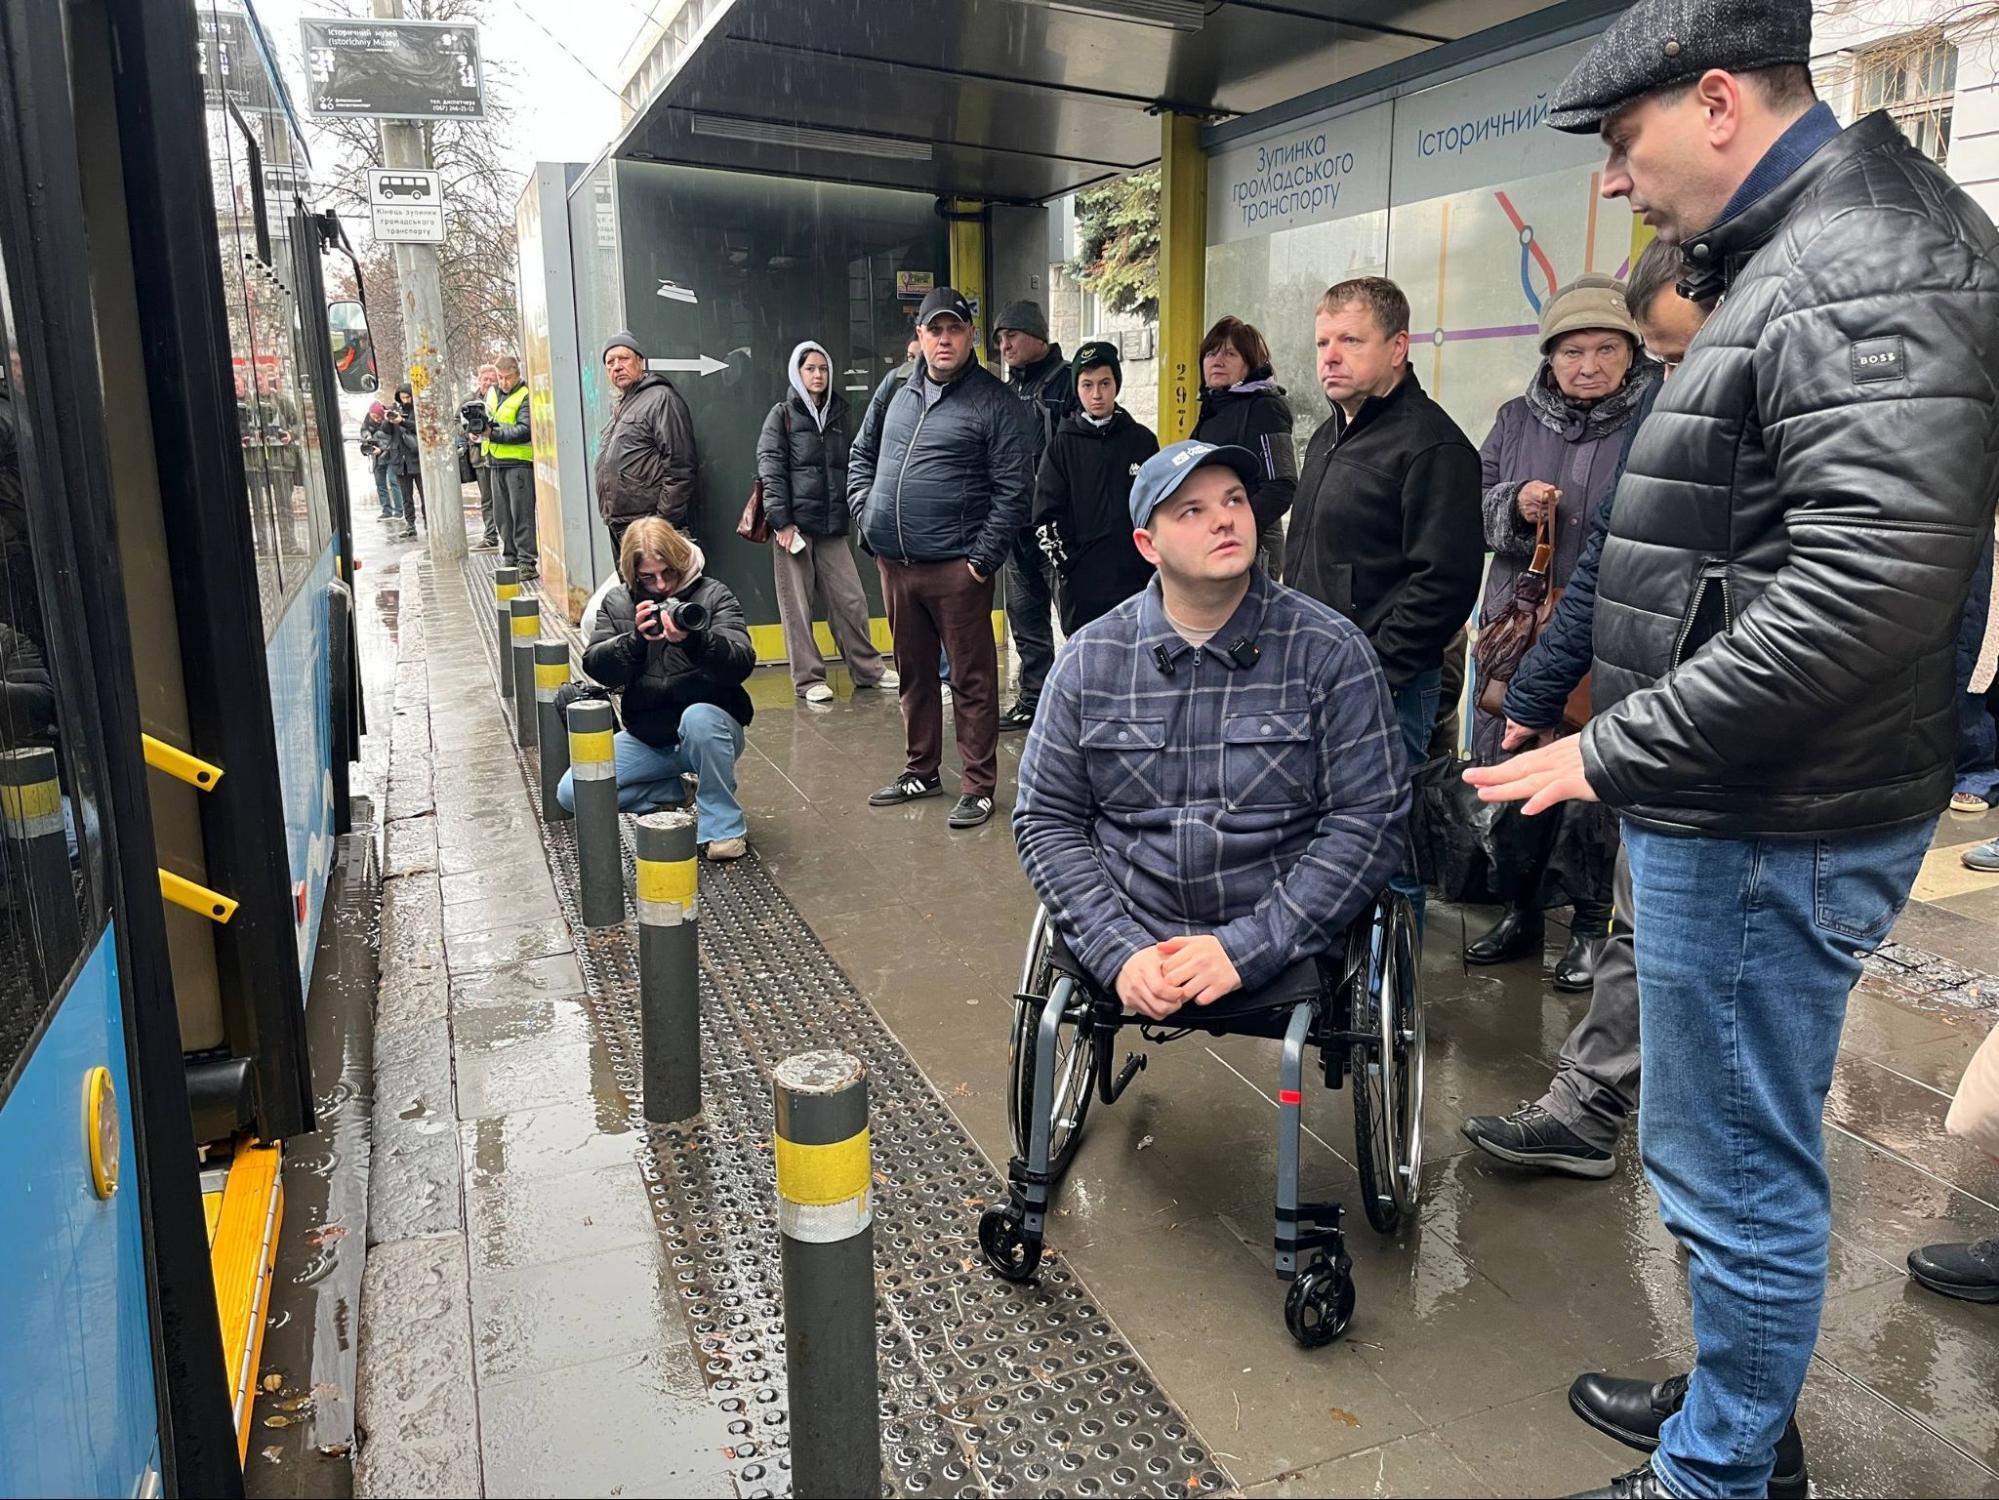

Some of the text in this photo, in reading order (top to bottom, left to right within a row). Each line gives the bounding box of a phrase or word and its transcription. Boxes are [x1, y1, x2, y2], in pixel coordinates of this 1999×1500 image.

[1417, 92, 1548, 158] Історичний
[1257, 133, 1326, 176] Зупинка
[1233, 152, 1354, 208] громадського
[1242, 181, 1341, 228] транспорту
[1860, 352, 1896, 365] BOSS
